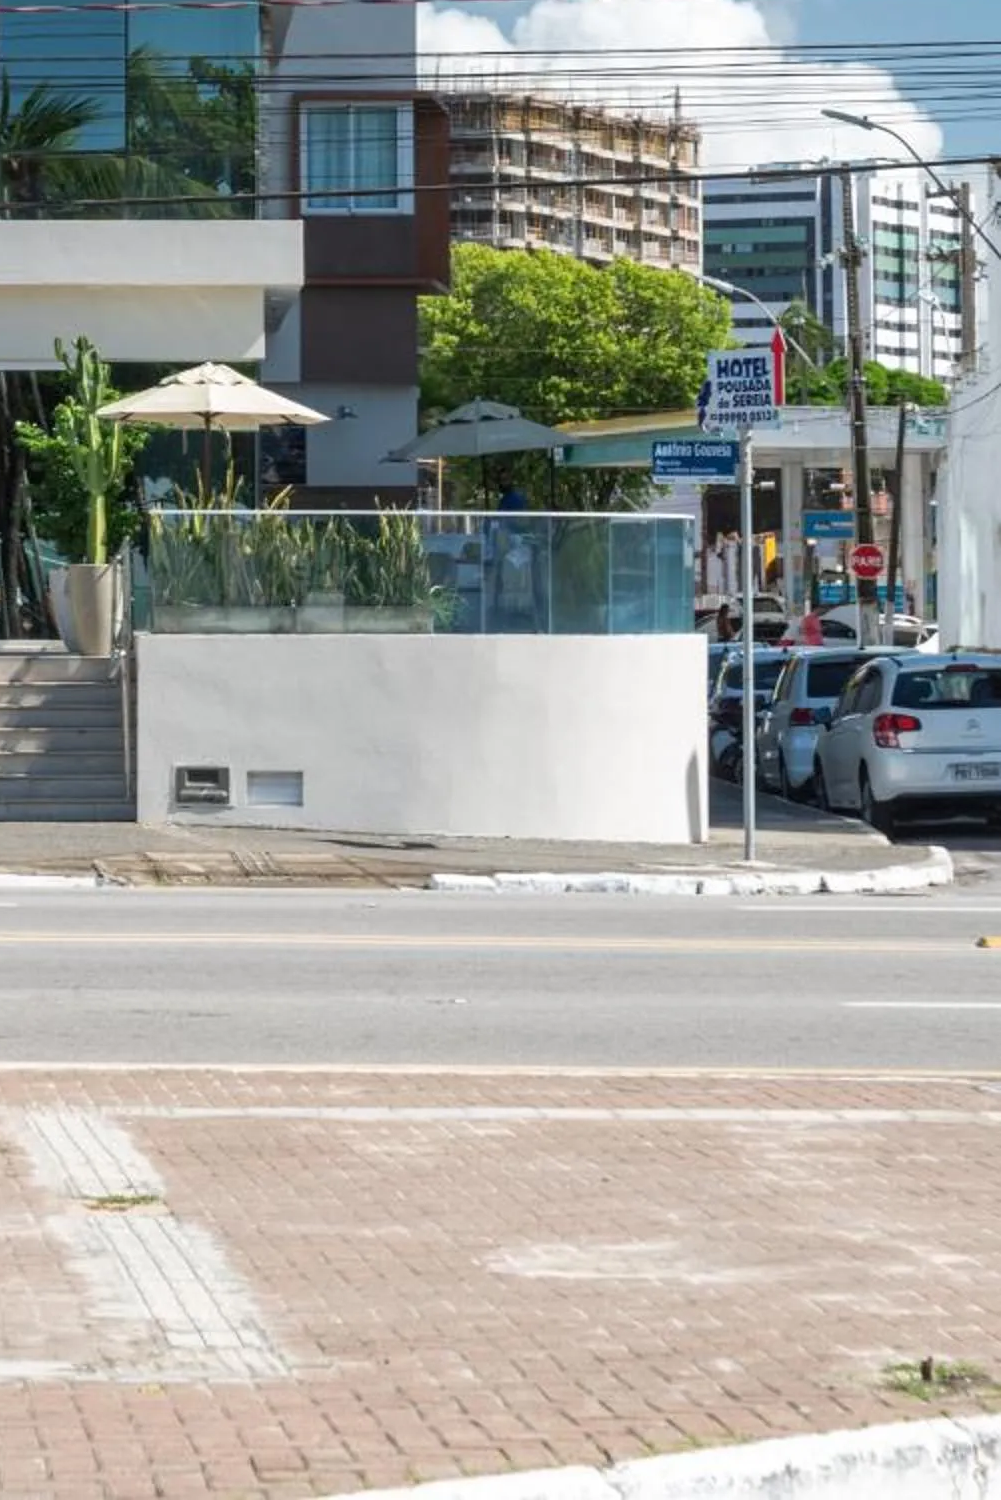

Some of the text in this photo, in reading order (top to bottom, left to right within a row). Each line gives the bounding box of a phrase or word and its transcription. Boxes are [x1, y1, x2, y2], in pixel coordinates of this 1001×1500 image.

[716, 357, 770, 378] HOTEL
[717, 379, 772, 393] POUSADA
[732, 393, 772, 407] SEREIA
